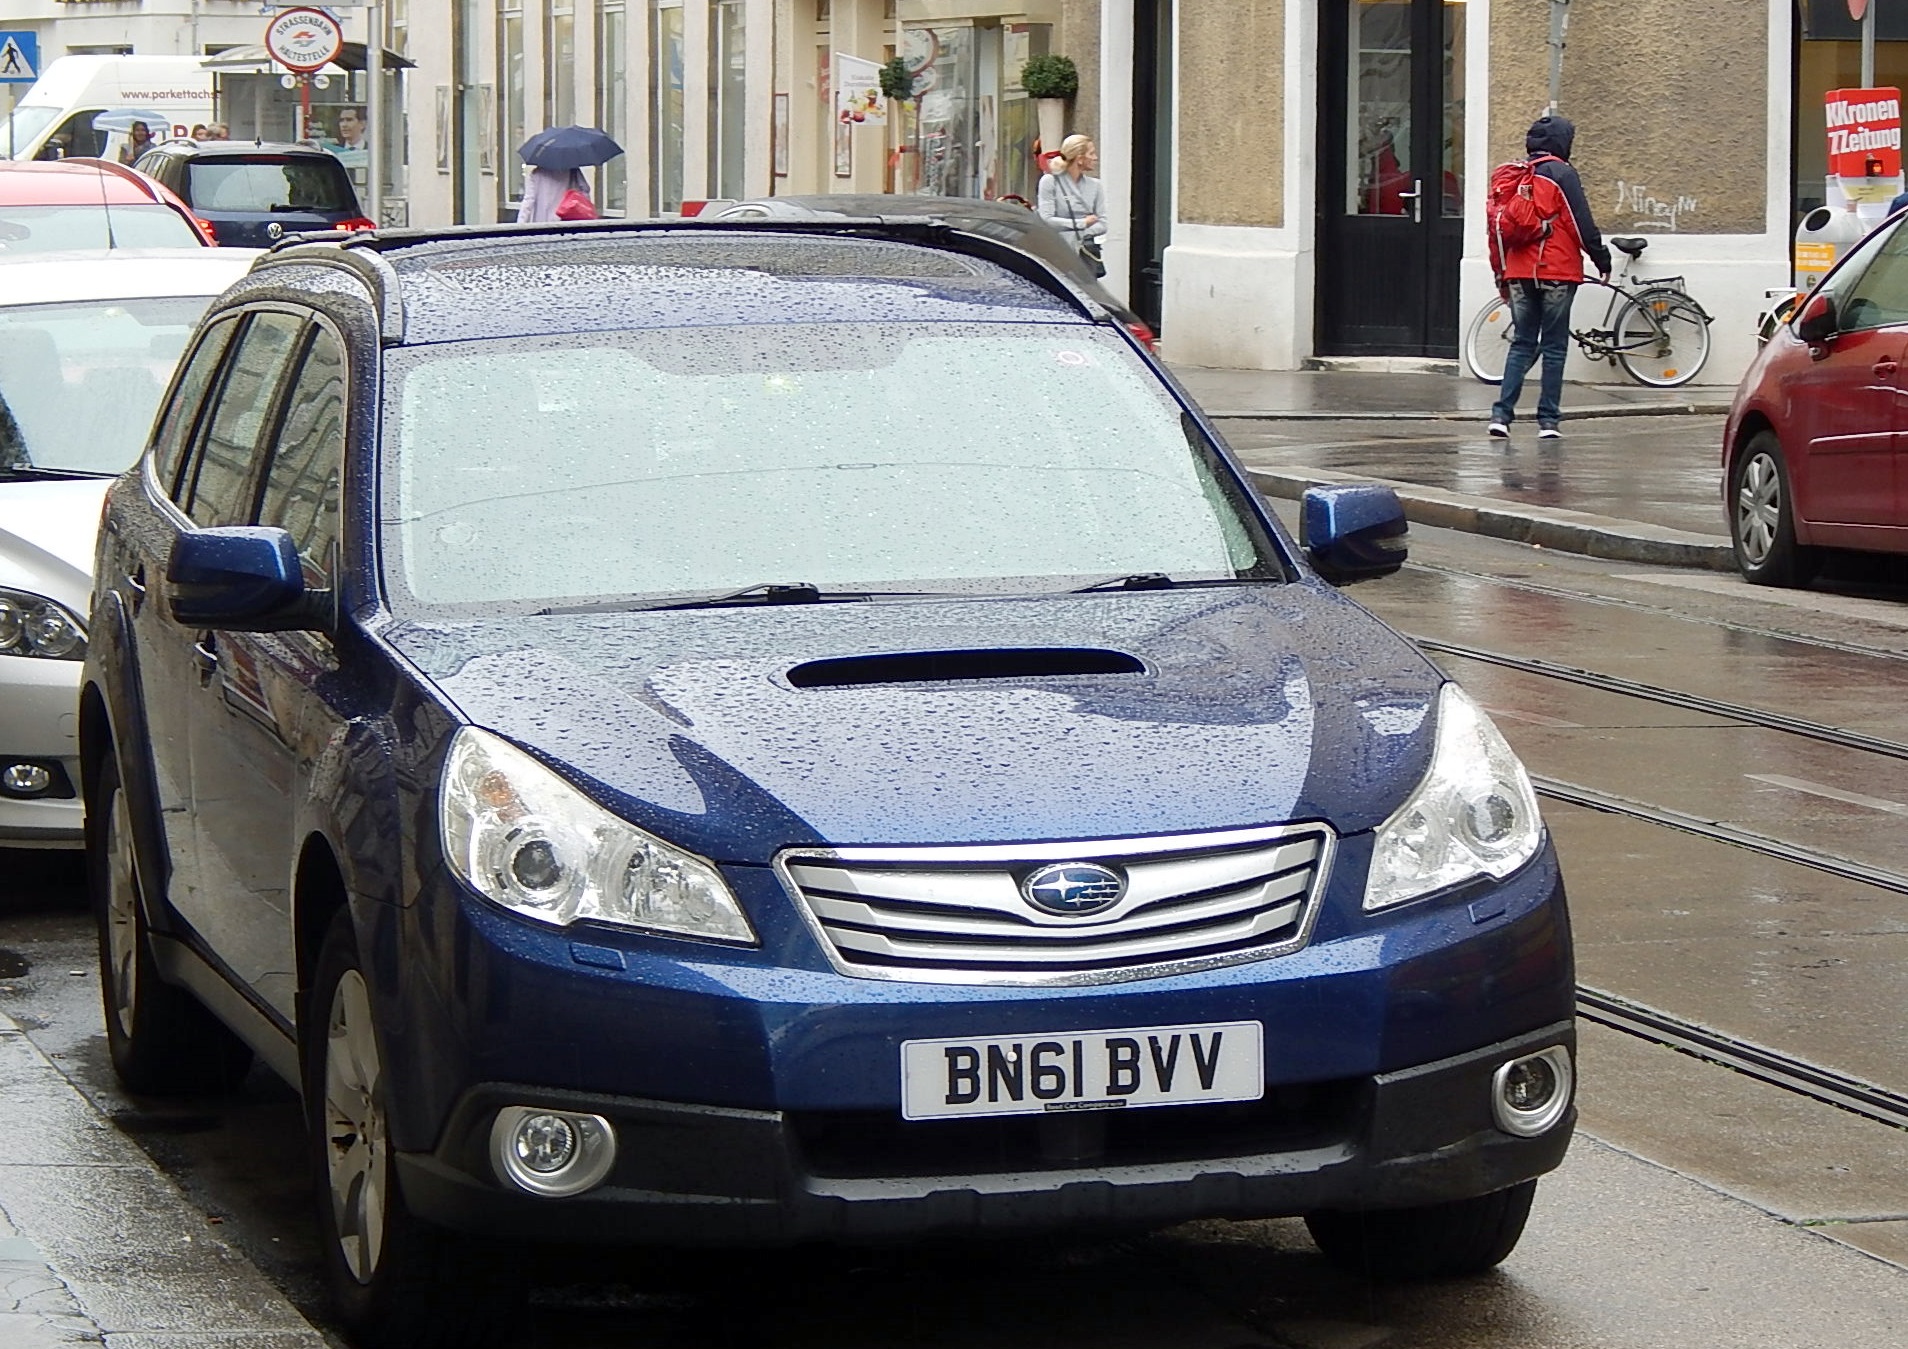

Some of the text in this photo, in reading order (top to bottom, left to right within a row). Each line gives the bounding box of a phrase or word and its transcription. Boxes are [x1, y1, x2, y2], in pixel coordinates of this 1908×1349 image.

[276, 15, 332, 36] STRASSENBAHN
[279, 45, 330, 62] HALTESTELLE
[944, 1031, 1223, 1105] BN61 BVV
